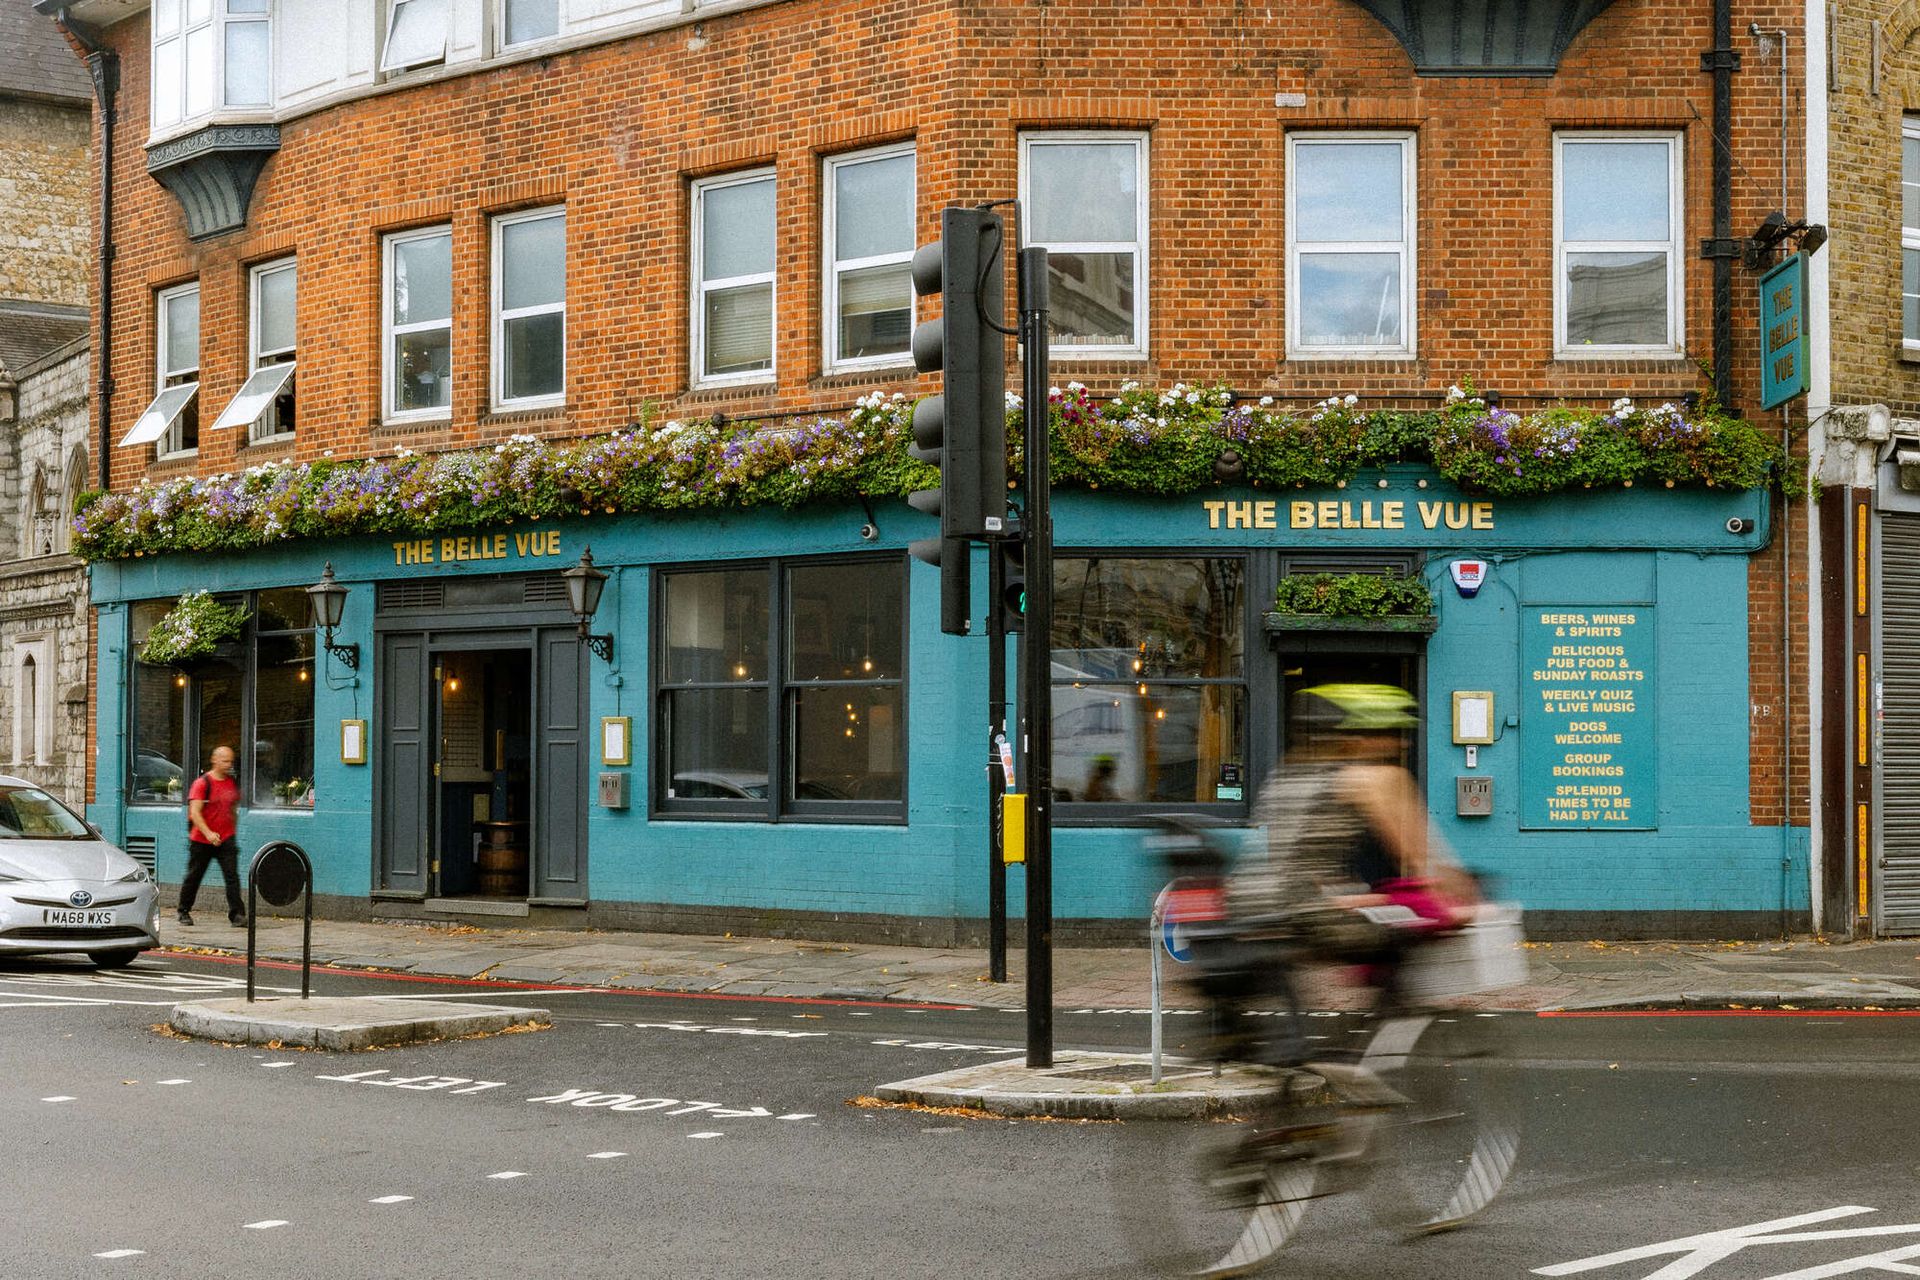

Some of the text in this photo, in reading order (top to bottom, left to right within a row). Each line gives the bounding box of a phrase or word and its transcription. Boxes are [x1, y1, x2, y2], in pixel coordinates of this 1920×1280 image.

[1772, 283, 1793, 317] THE
[1769, 313, 1798, 354] BELLE
[1773, 352, 1794, 385] VUE
[1203, 501, 1495, 529] THE BELLE VUE
[393, 531, 561, 565] THE BELLE VUE
[1541, 614, 1636, 626] BEERS, WINES
[1555, 626, 1622, 637] & SPIRITS
[1552, 645, 1624, 656] DELICIOUS
[1547, 658, 1629, 668] PUB FOOD &
[1533, 670, 1644, 681] SUNDAY ROASTS
[1542, 690, 1633, 700] WEEKLY QUIZ
[1544, 702, 1635, 713] & LIVE MUSIC
[1569, 721, 1607, 732] DOGS
[1555, 734, 1622, 744] WELCOME
[1564, 753, 1612, 764] GROUP
[1552, 766, 1624, 777] BOOKINGS
[1556, 785, 1622, 796] SPLENDID
[1547, 798, 1631, 808] TIMES TO BE
[1550, 810, 1629, 821] HAD BY ALL
[51, 911, 112, 924] MA68 WXS
[315, 1070, 721, 1115] LOOK LEFT
